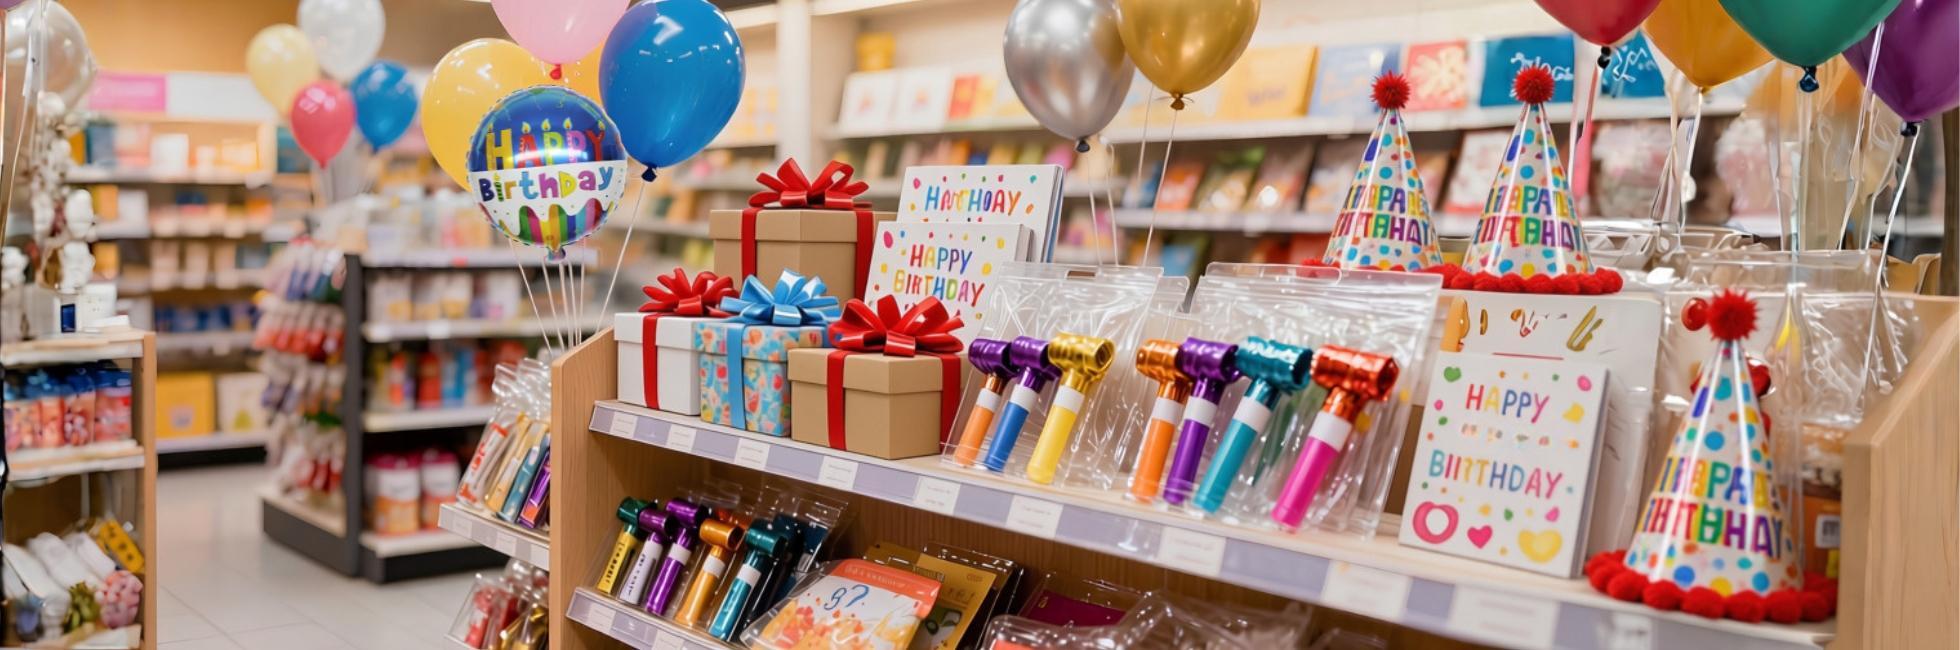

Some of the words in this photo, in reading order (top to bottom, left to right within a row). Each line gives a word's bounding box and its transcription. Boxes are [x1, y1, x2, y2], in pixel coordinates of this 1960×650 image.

[486, 127, 606, 171] HAPPY
[910, 243, 973, 275] HAPPY
[1465, 383, 1550, 424] HAPPY
